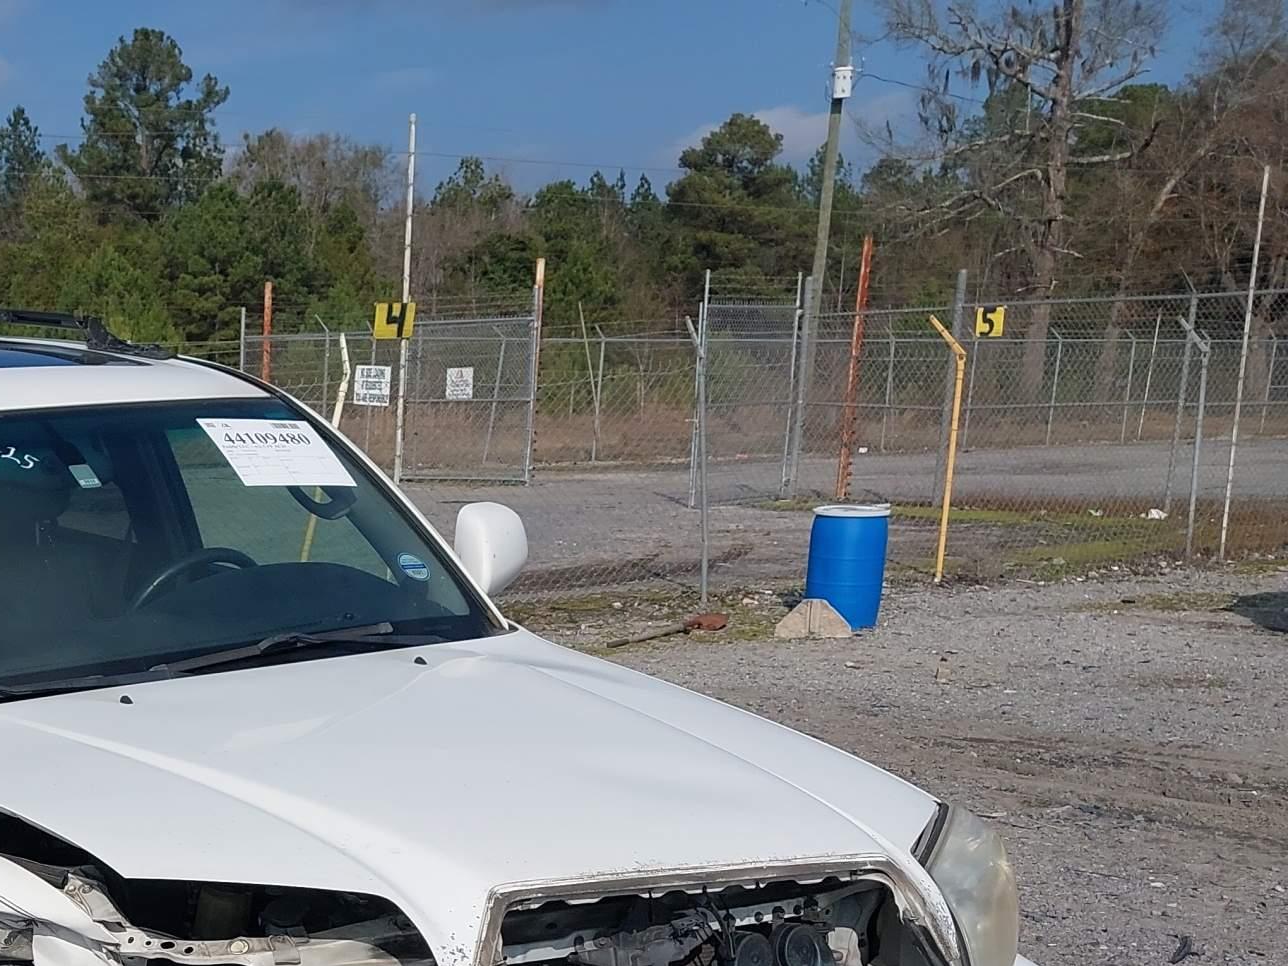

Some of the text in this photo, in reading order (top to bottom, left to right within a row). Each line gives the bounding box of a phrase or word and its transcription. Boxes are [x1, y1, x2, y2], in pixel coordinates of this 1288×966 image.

[387, 303, 407, 337] 4
[979, 304, 996, 337] 5
[224, 432, 311, 445] 44109480
